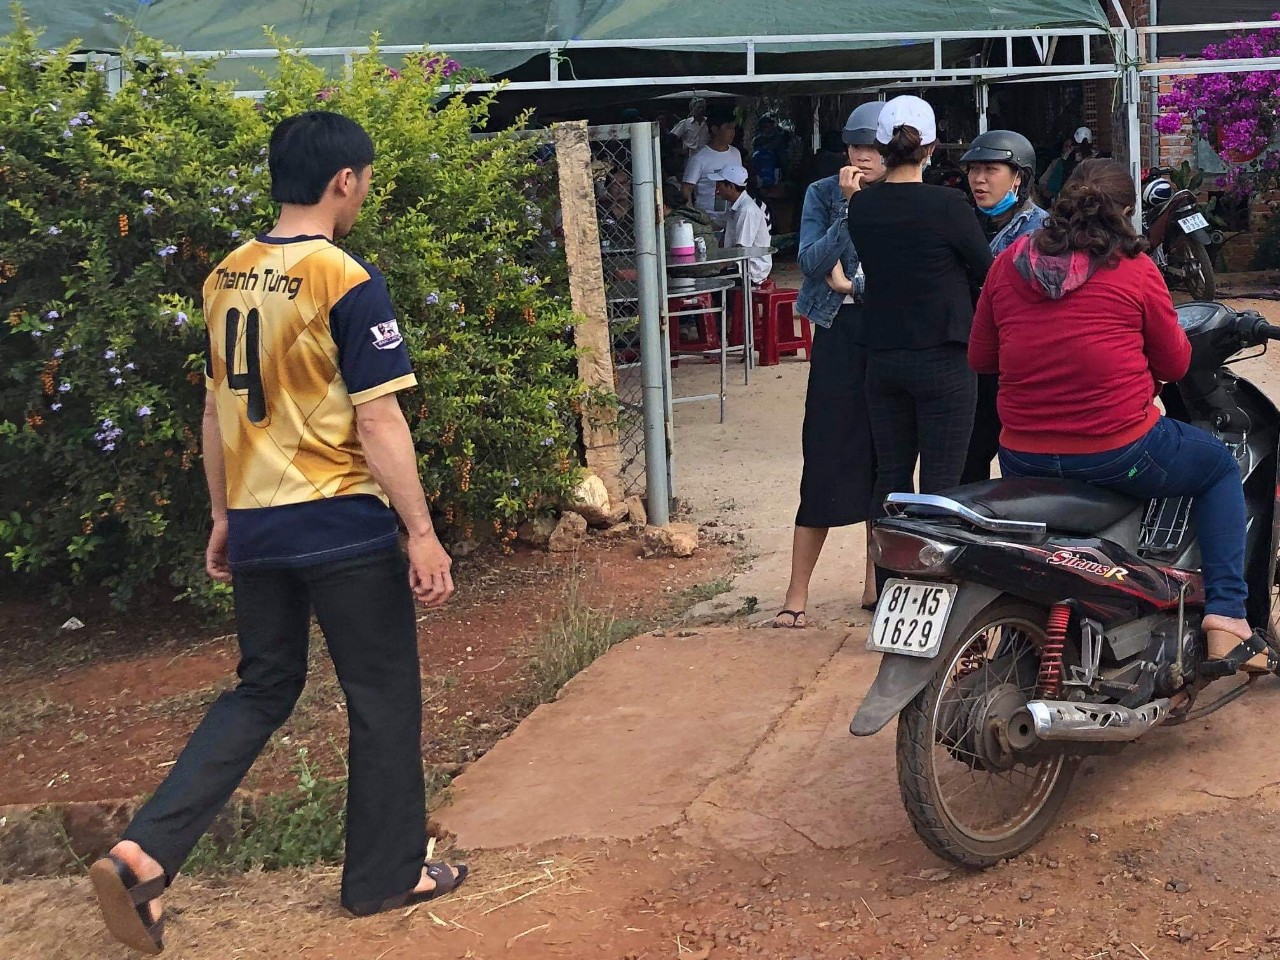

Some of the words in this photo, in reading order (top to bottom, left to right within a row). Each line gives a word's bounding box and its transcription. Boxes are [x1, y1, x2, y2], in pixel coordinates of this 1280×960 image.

[214, 266, 259, 291] Thanh
[226, 307, 267, 423] 4
[880, 616, 933, 648] 1629
